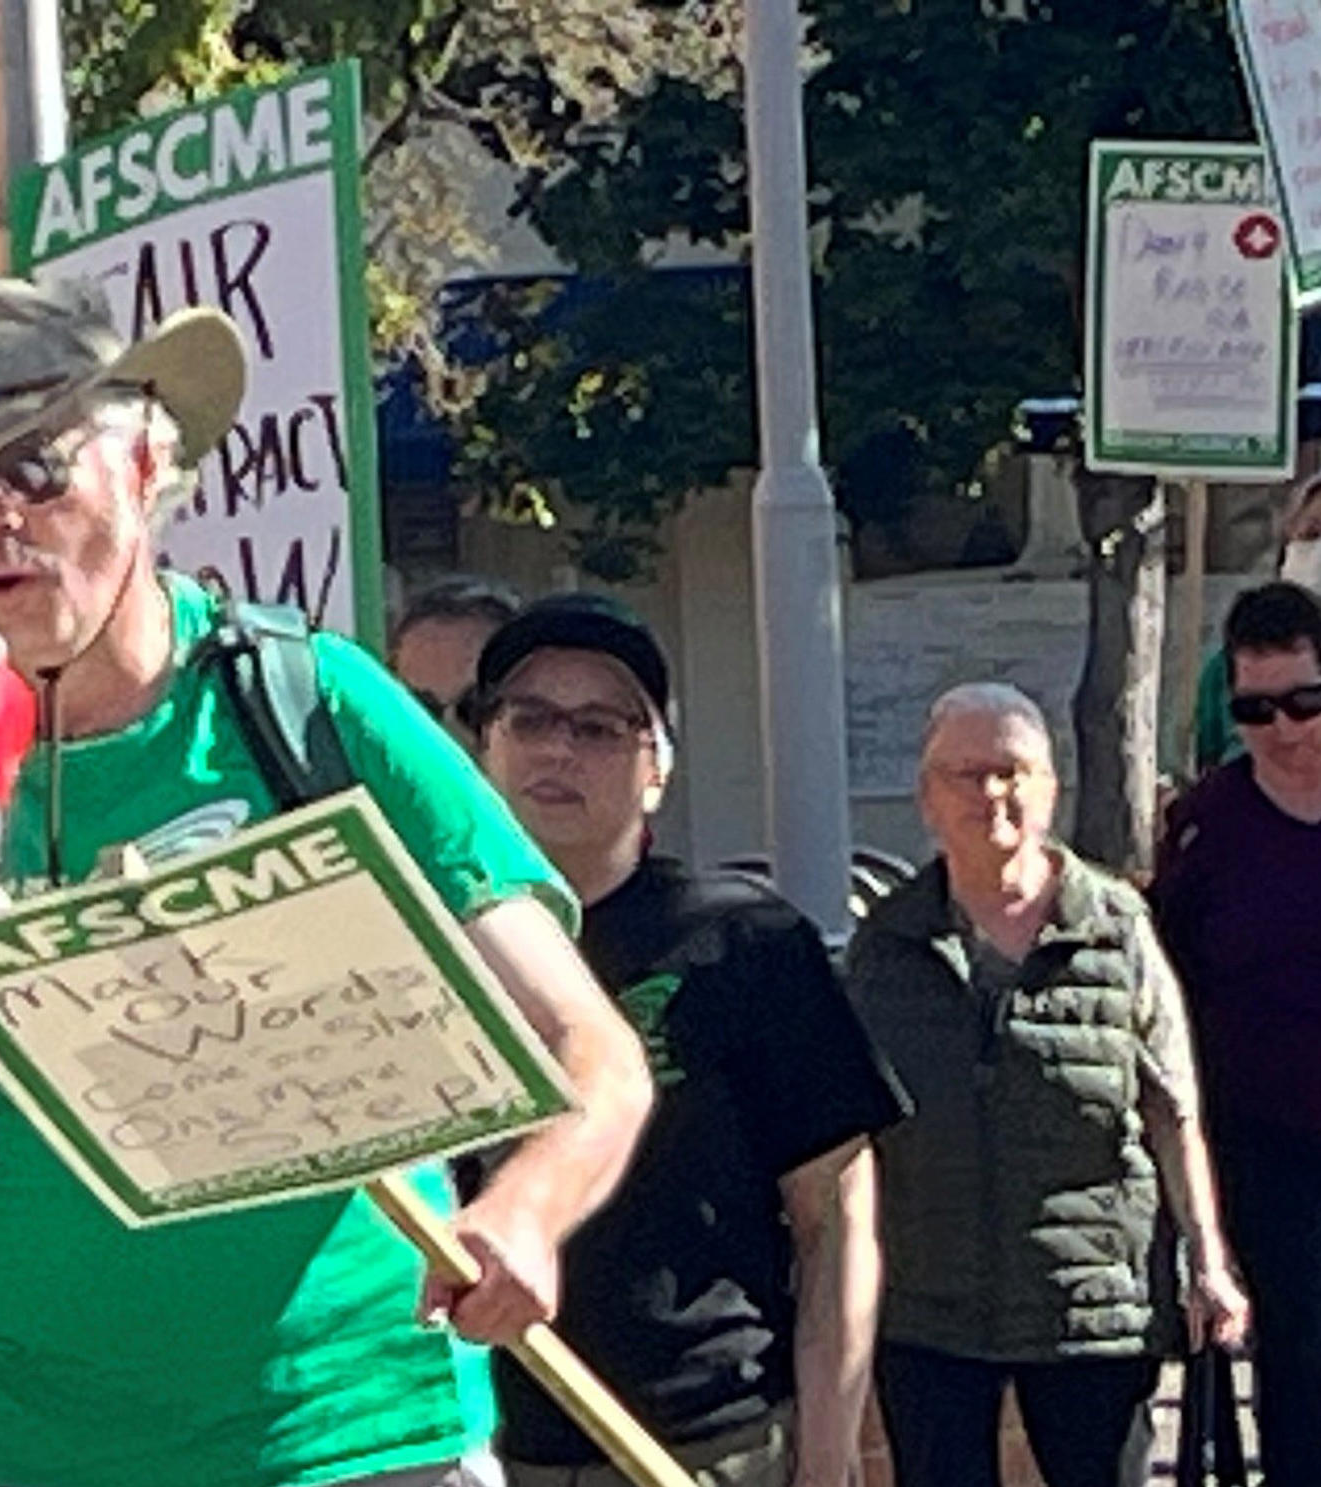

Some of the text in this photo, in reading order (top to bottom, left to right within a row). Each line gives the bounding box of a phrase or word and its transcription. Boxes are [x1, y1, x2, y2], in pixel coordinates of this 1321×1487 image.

[30, 76, 333, 258] AFSCME
[1106, 157, 1264, 200] AFSCM
[174, 395, 349, 521] RACT
[123, 964, 288, 1026] Our
